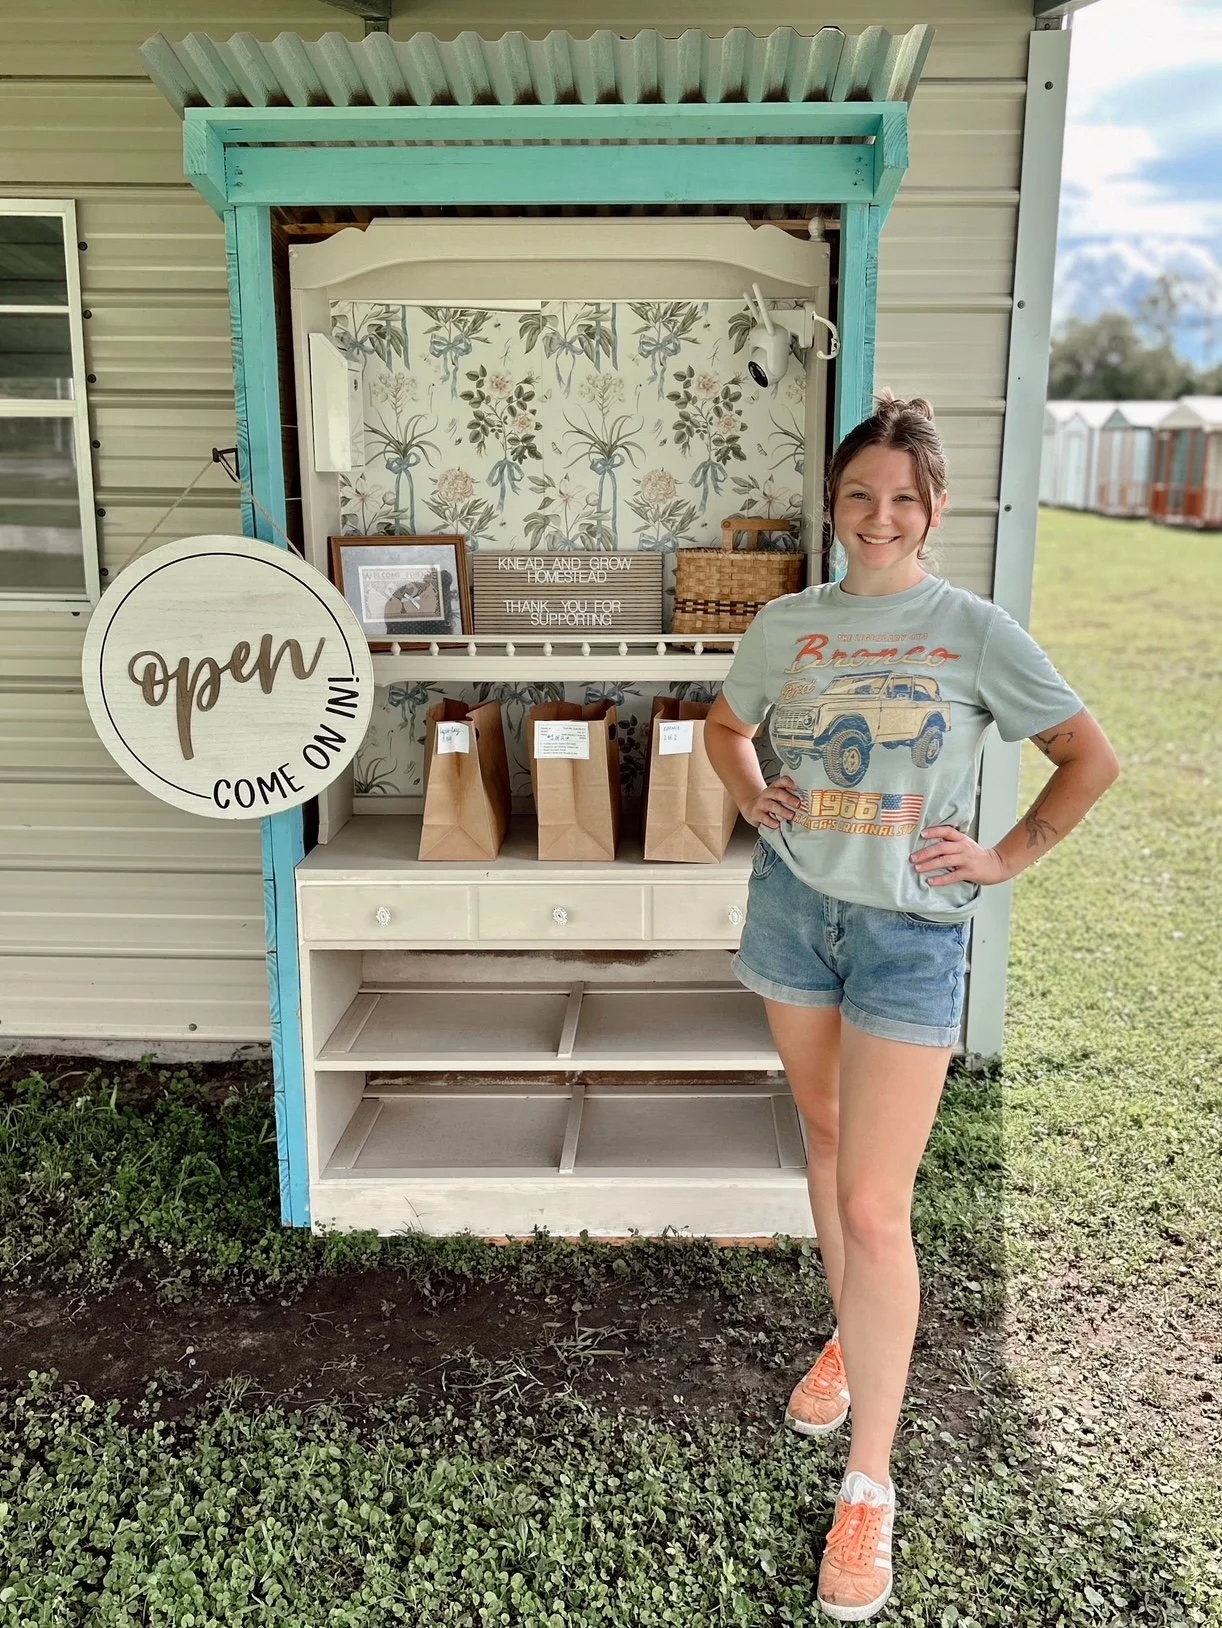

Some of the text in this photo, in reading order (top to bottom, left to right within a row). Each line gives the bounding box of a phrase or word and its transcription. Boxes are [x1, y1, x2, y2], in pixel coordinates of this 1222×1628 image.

[498, 557, 632, 570] KNEAD AND GROW
[527, 570, 607, 583] HOMESTEAD
[503, 600, 621, 613] THANK YOU FOR
[530, 612, 612, 626] SUPPORTING
[784, 633, 960, 674] Bronco
[128, 633, 326, 760] open
[213, 676, 360, 809] COME ON IN!
[810, 789, 882, 821] 1966
[837, 820, 895, 837] ORIGINAL
